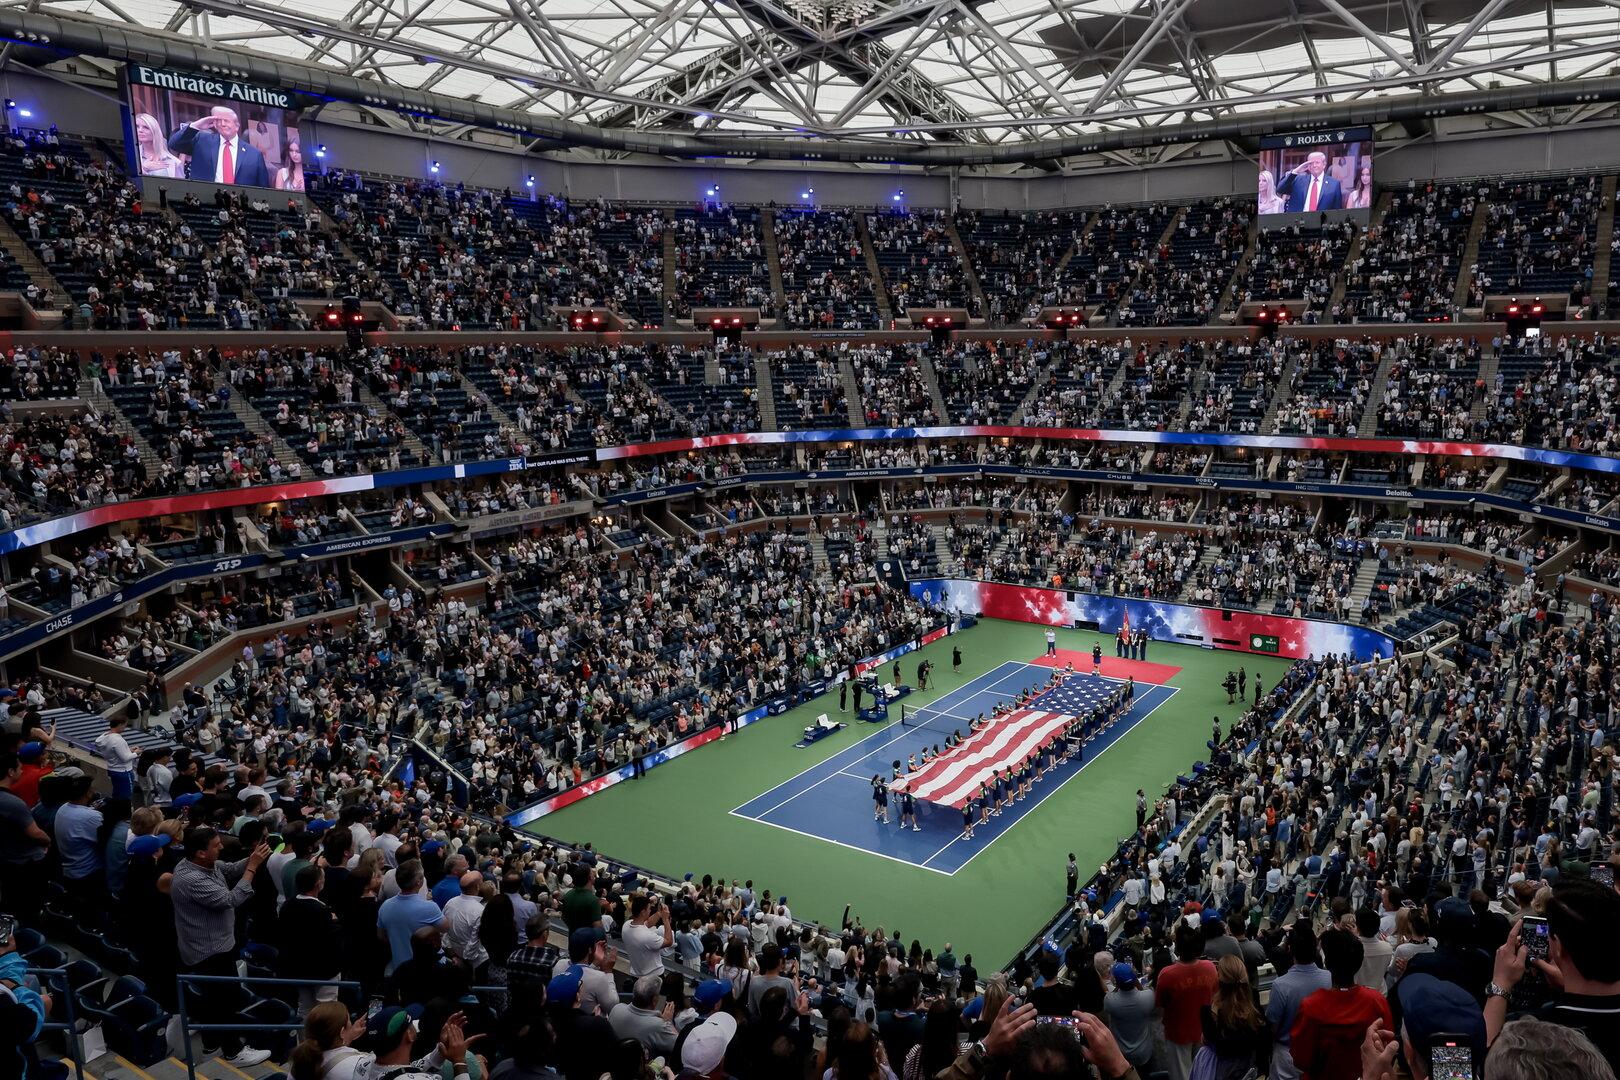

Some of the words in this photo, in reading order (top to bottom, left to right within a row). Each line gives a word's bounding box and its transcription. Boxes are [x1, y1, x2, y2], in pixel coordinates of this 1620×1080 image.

[139, 66, 225, 96] Emirates
[229, 83, 289, 108] Airline
[1297, 134, 1332, 145] ROLEX
[508, 462, 524, 471] IBM
[646, 490, 666, 498] Emirates
[1385, 489, 1414, 497] Deloitte.
[488, 516, 520, 527] ARTHUR
[1585, 516, 1610, 527] Emirates
[326, 541, 361, 552] AMERICAN
[362, 536, 392, 546] EXPRESS
[213, 558, 242, 572] ATP
[45, 614, 73, 634] CHASE
